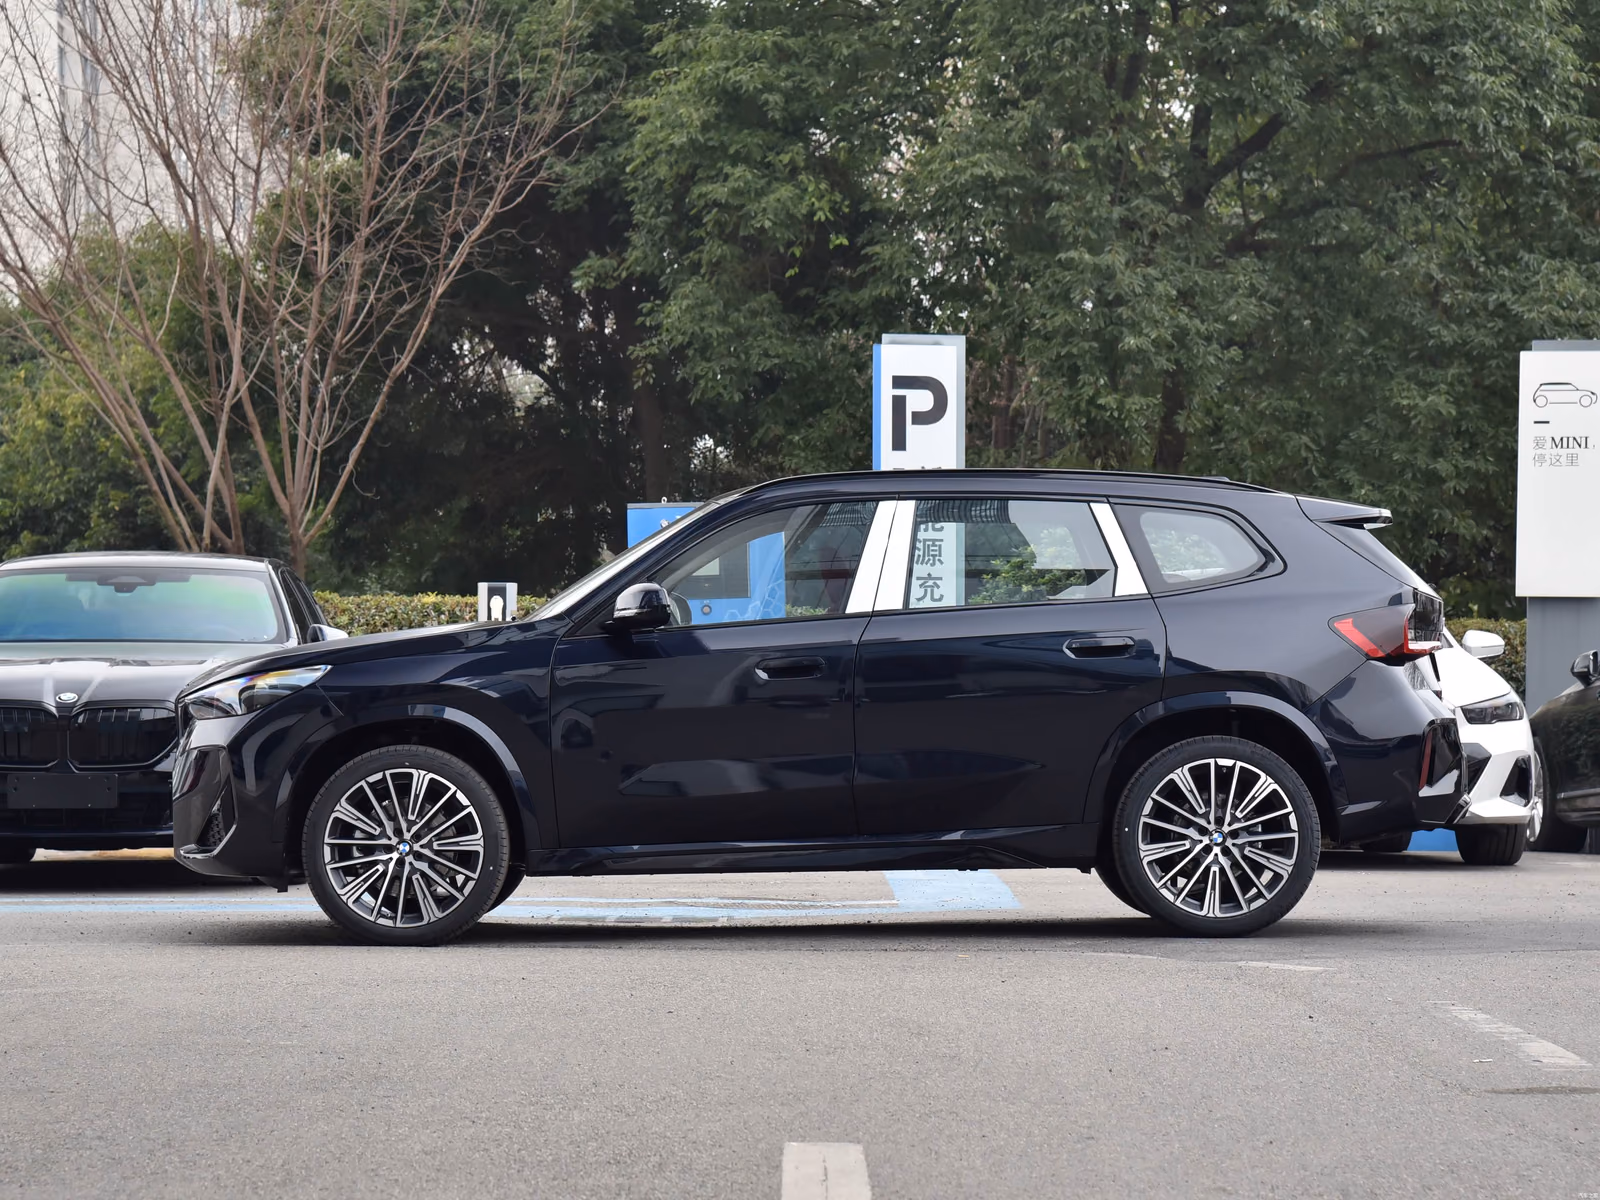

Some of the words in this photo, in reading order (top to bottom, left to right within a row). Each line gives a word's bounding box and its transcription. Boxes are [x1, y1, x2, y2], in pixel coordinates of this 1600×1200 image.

[892, 376, 949, 451] P
[1532, 452, 1580, 467] 停这里
